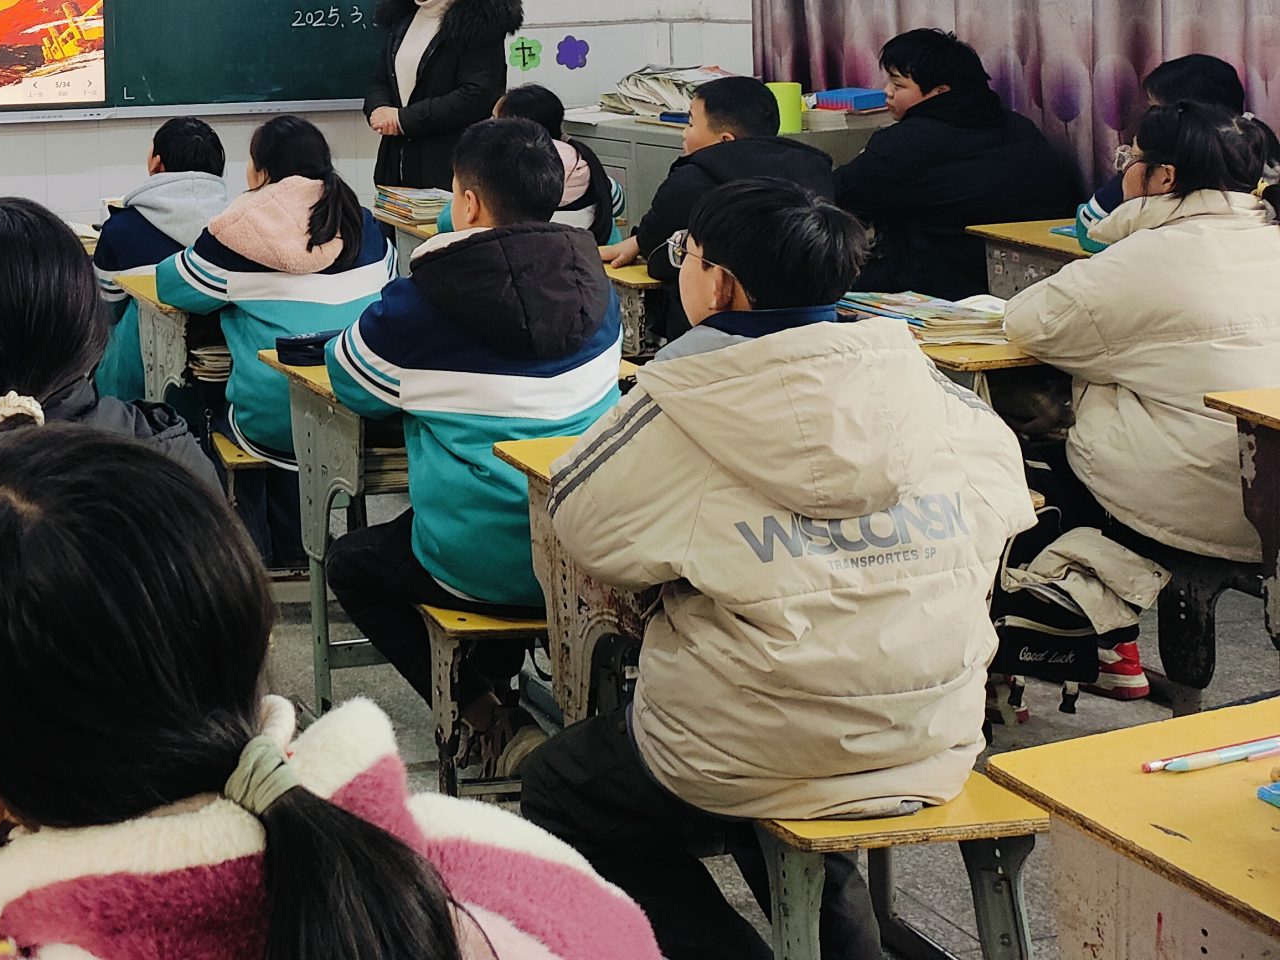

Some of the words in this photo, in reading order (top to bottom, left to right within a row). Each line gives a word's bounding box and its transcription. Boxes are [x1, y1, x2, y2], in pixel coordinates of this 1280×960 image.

[291, 6, 378, 29] 2025.3.
[828, 549, 919, 571] TRANSPORTES
[925, 547, 937, 559] SP
[1019, 646, 1049, 661] Good
